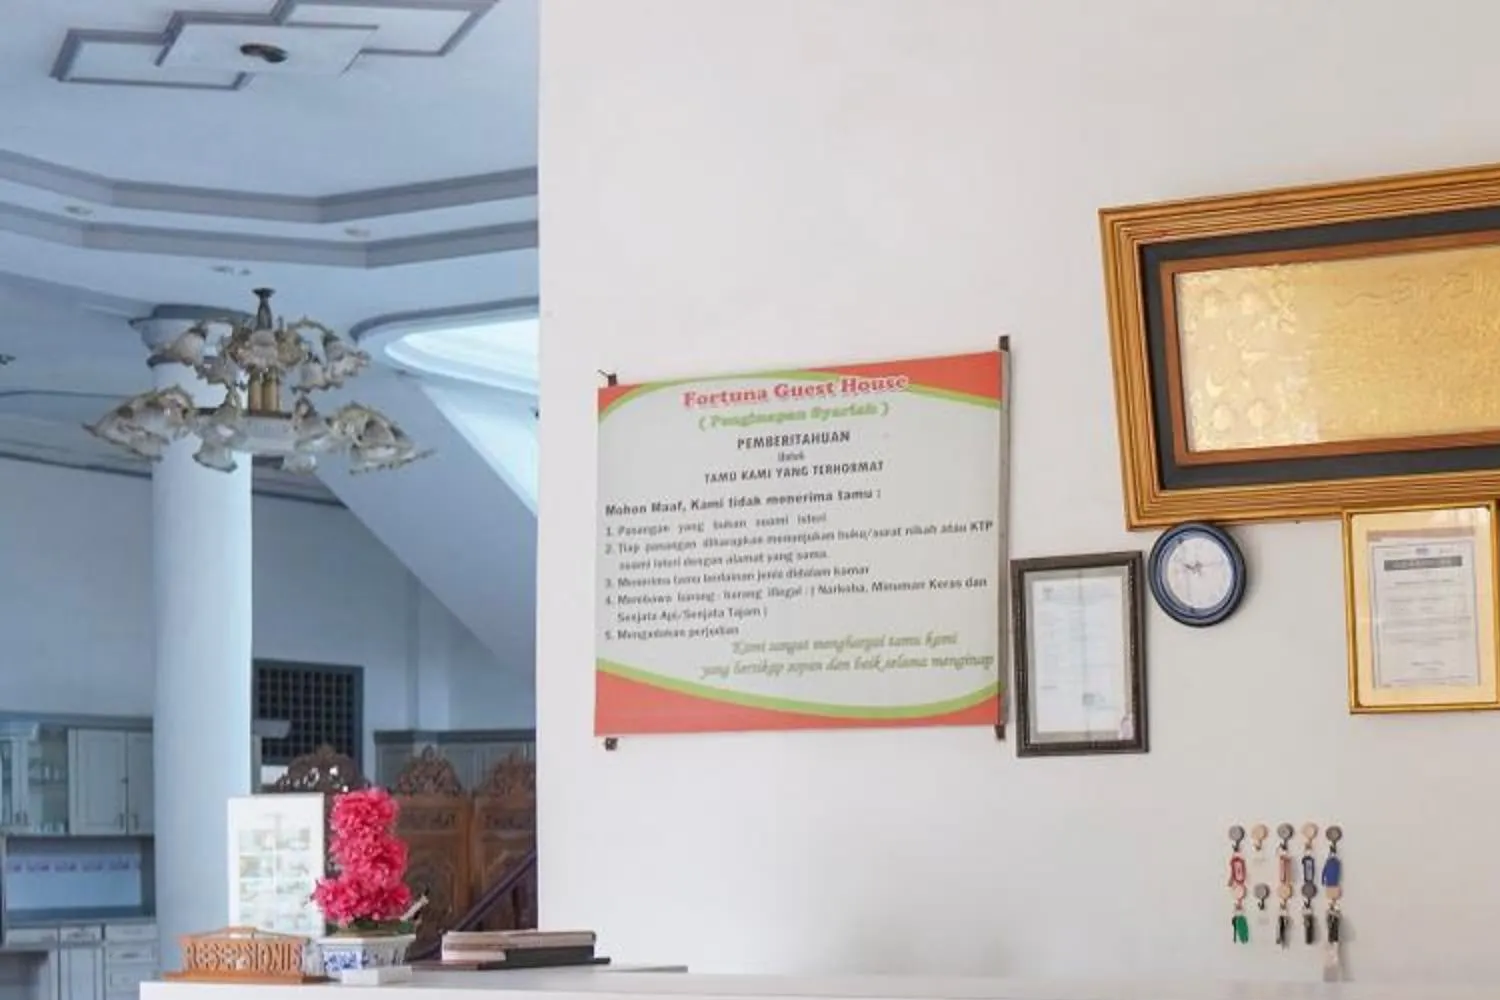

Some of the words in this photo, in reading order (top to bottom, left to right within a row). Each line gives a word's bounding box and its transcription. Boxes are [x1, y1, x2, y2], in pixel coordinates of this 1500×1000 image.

[683, 389, 768, 408] Fortuna
[774, 381, 834, 400] Guest
[840, 375, 908, 395] House
[737, 431, 850, 450] PEMBERITAHUAN
[704, 473, 737, 484] TAMU
[741, 469, 771, 481] KAMI
[776, 465, 808, 479] YANG
[813, 461, 884, 476] TERHORMAT
[605, 503, 647, 516] Mohon
[691, 499, 724, 511] Kami
[728, 496, 761, 508] tidak
[766, 493, 833, 506] menerima
[838, 490, 873, 502] tamu
[679, 522, 704, 534] yang
[970, 520, 993, 533] KTP
[929, 577, 962, 590] Keras
[965, 576, 988, 588] dan
